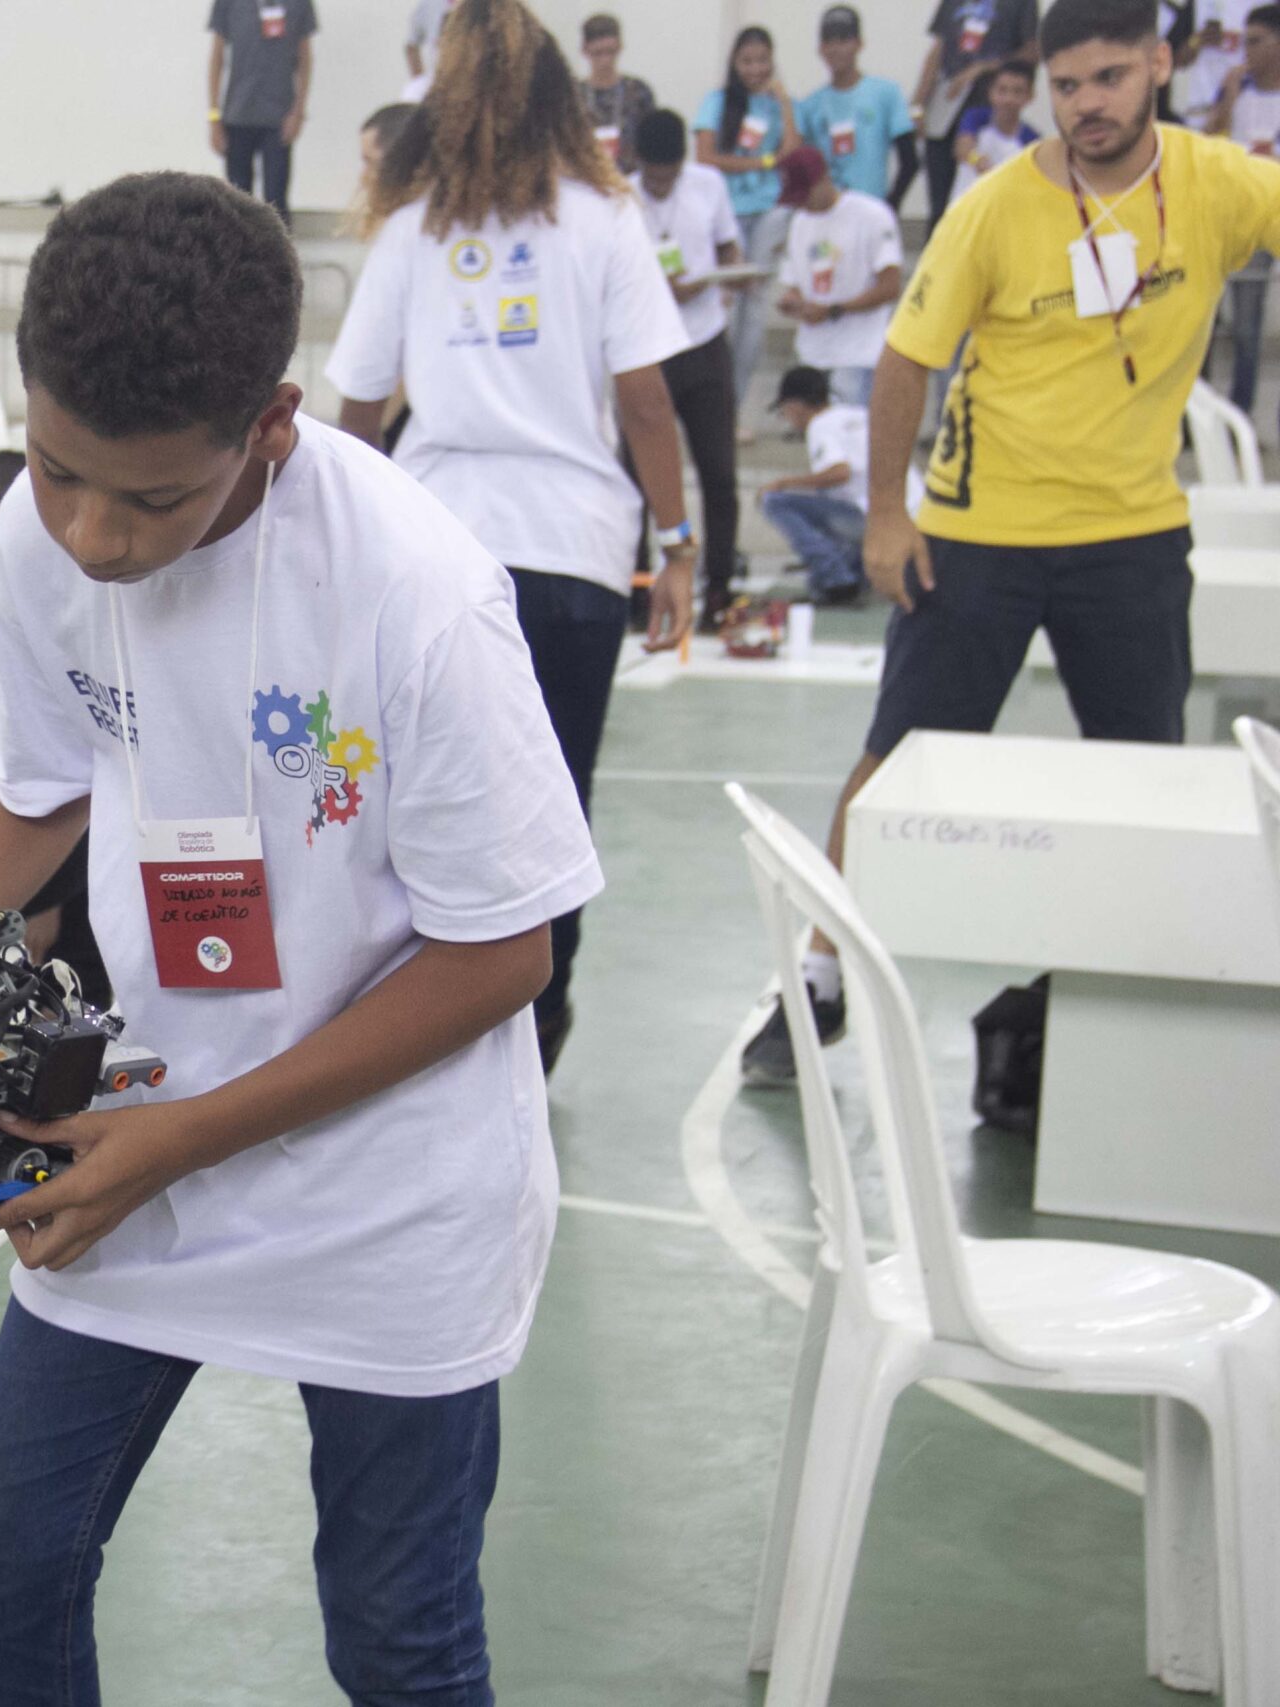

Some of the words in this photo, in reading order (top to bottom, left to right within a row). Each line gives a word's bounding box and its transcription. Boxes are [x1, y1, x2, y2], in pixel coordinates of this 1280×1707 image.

[273, 743, 349, 800] OBR
[159, 872, 245, 882] COMPETIDOR
[160, 908, 179, 922] DE
